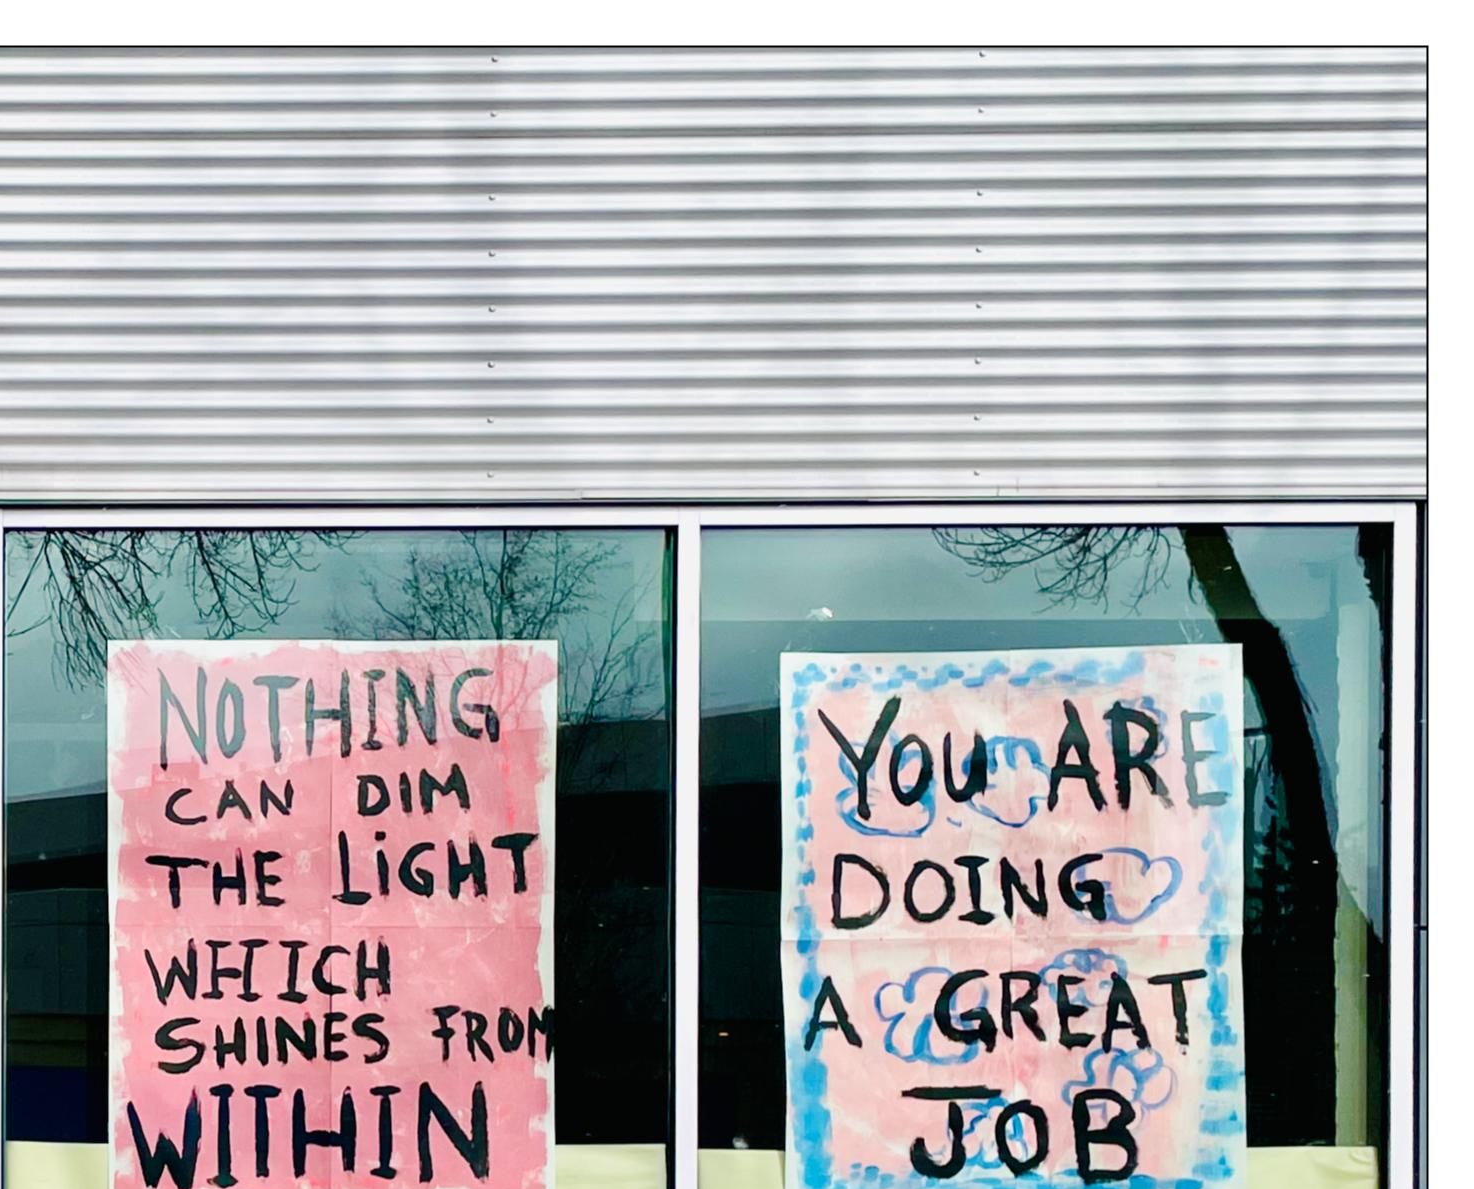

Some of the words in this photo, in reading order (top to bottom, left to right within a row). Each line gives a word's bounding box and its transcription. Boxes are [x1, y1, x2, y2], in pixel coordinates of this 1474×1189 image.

[156, 666, 500, 771] NOTHING
[1046, 699, 1233, 813] ARE
[164, 779, 296, 826] CAN
[355, 763, 471, 818] DIM
[144, 847, 287, 909] THE
[830, 852, 1108, 930] DOING
[143, 936, 392, 1006] WHICH
[154, 1010, 391, 1075] SHINES
[431, 1003, 556, 1064] FROM
[802, 976, 864, 1052] A
[933, 968, 1208, 1055] GREAT
[900, 1085, 1140, 1187] JOB
